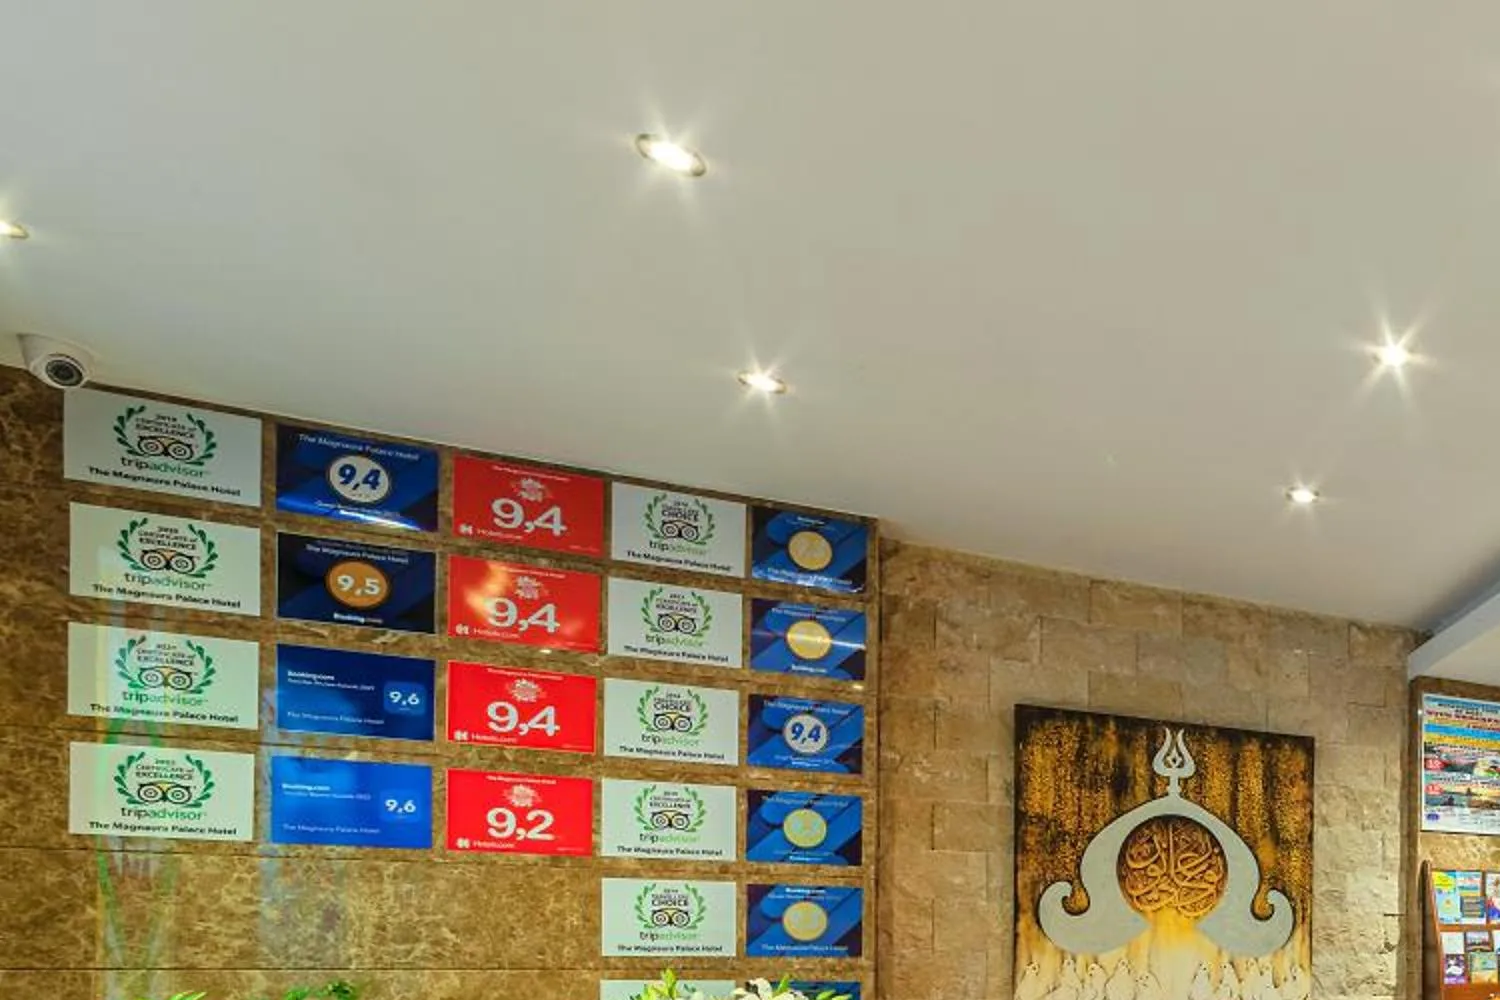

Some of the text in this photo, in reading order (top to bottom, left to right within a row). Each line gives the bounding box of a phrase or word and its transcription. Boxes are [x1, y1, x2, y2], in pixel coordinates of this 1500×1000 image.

[121, 457, 205, 477] tripadvisor
[338, 464, 381, 490] 9,4
[89, 466, 109, 477] The
[174, 479, 208, 491] Palace
[211, 485, 241, 496] Hotel
[491, 498, 568, 537] 9,4
[124, 573, 206, 591] tripadvisor
[337, 575, 380, 596] 9,5
[93, 584, 113, 593] The
[175, 594, 209, 605] Palace
[212, 598, 241, 608] Hotel
[485, 597, 561, 633] 9,4
[122, 691, 204, 706] tripadvisor
[91, 703, 110, 712] The
[173, 711, 206, 721] Palace
[209, 714, 239, 723] Hotel
[487, 701, 561, 737] 9,4
[791, 722, 821, 744] 9,4
[120, 807, 203, 821] tripadvisor
[486, 807, 555, 841] 9,2
[89, 821, 109, 830] The
[171, 825, 205, 834] Palace
[208, 827, 237, 835] Hotel
